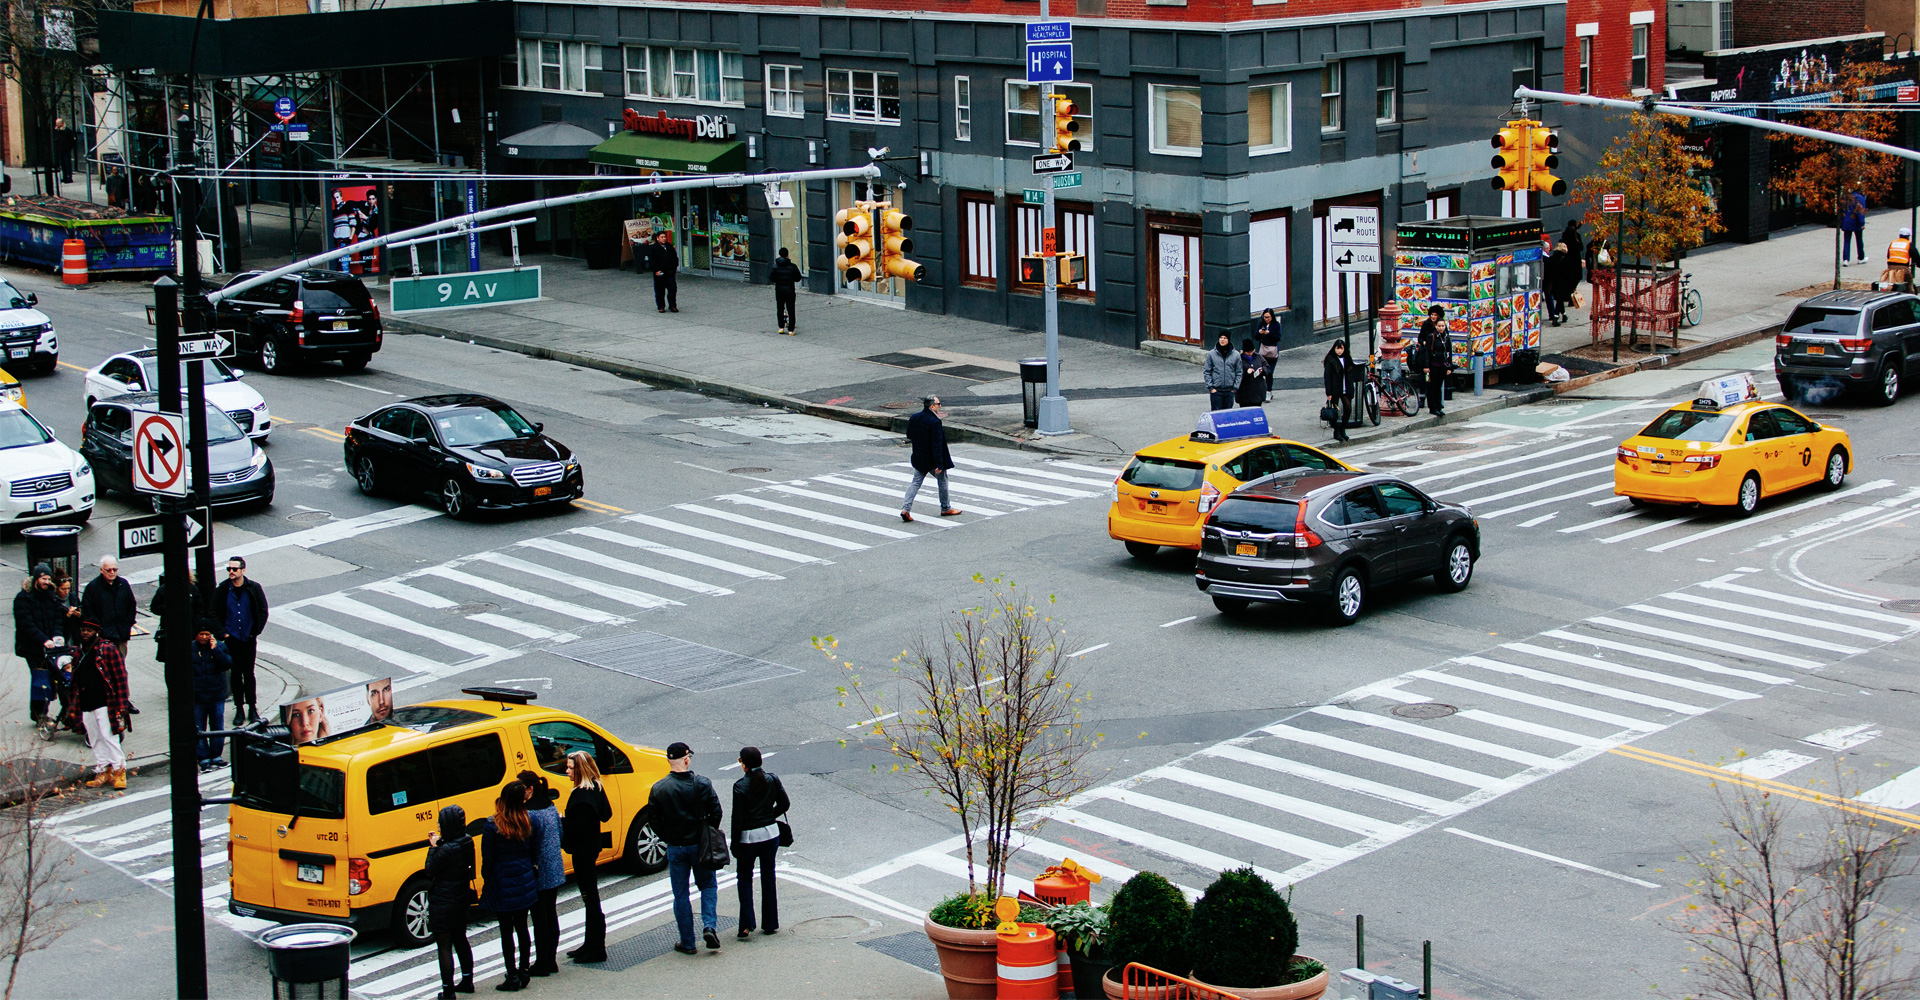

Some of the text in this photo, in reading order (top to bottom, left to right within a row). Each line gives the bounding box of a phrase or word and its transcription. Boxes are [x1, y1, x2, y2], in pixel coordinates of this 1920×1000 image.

[1032, 31, 1065, 39] HEALTHPLEX
[1711, 88, 1737, 102] PAPYRUS
[622, 108, 726, 142] Strawberry Deli
[636, 158, 660, 168] FREE DELIVERY
[1038, 158, 1068, 169] ONE WAY
[1053, 174, 1075, 188] HUDSON
[1025, 190, 1031, 202] W
[1032, 191, 1039, 202] 14
[1356, 215, 1376, 224] TRUCK
[1356, 228, 1376, 237] ROUTE
[1357, 254, 1376, 263] LOCAL
[437, 280, 498, 303] 9 Av
[203, 339, 225, 351] WAY
[1670, 449, 1684, 457] 532
[131, 527, 157, 545] ONE
[415, 810, 433, 822] 9K15
[316, 831, 339, 842] UTC 20
